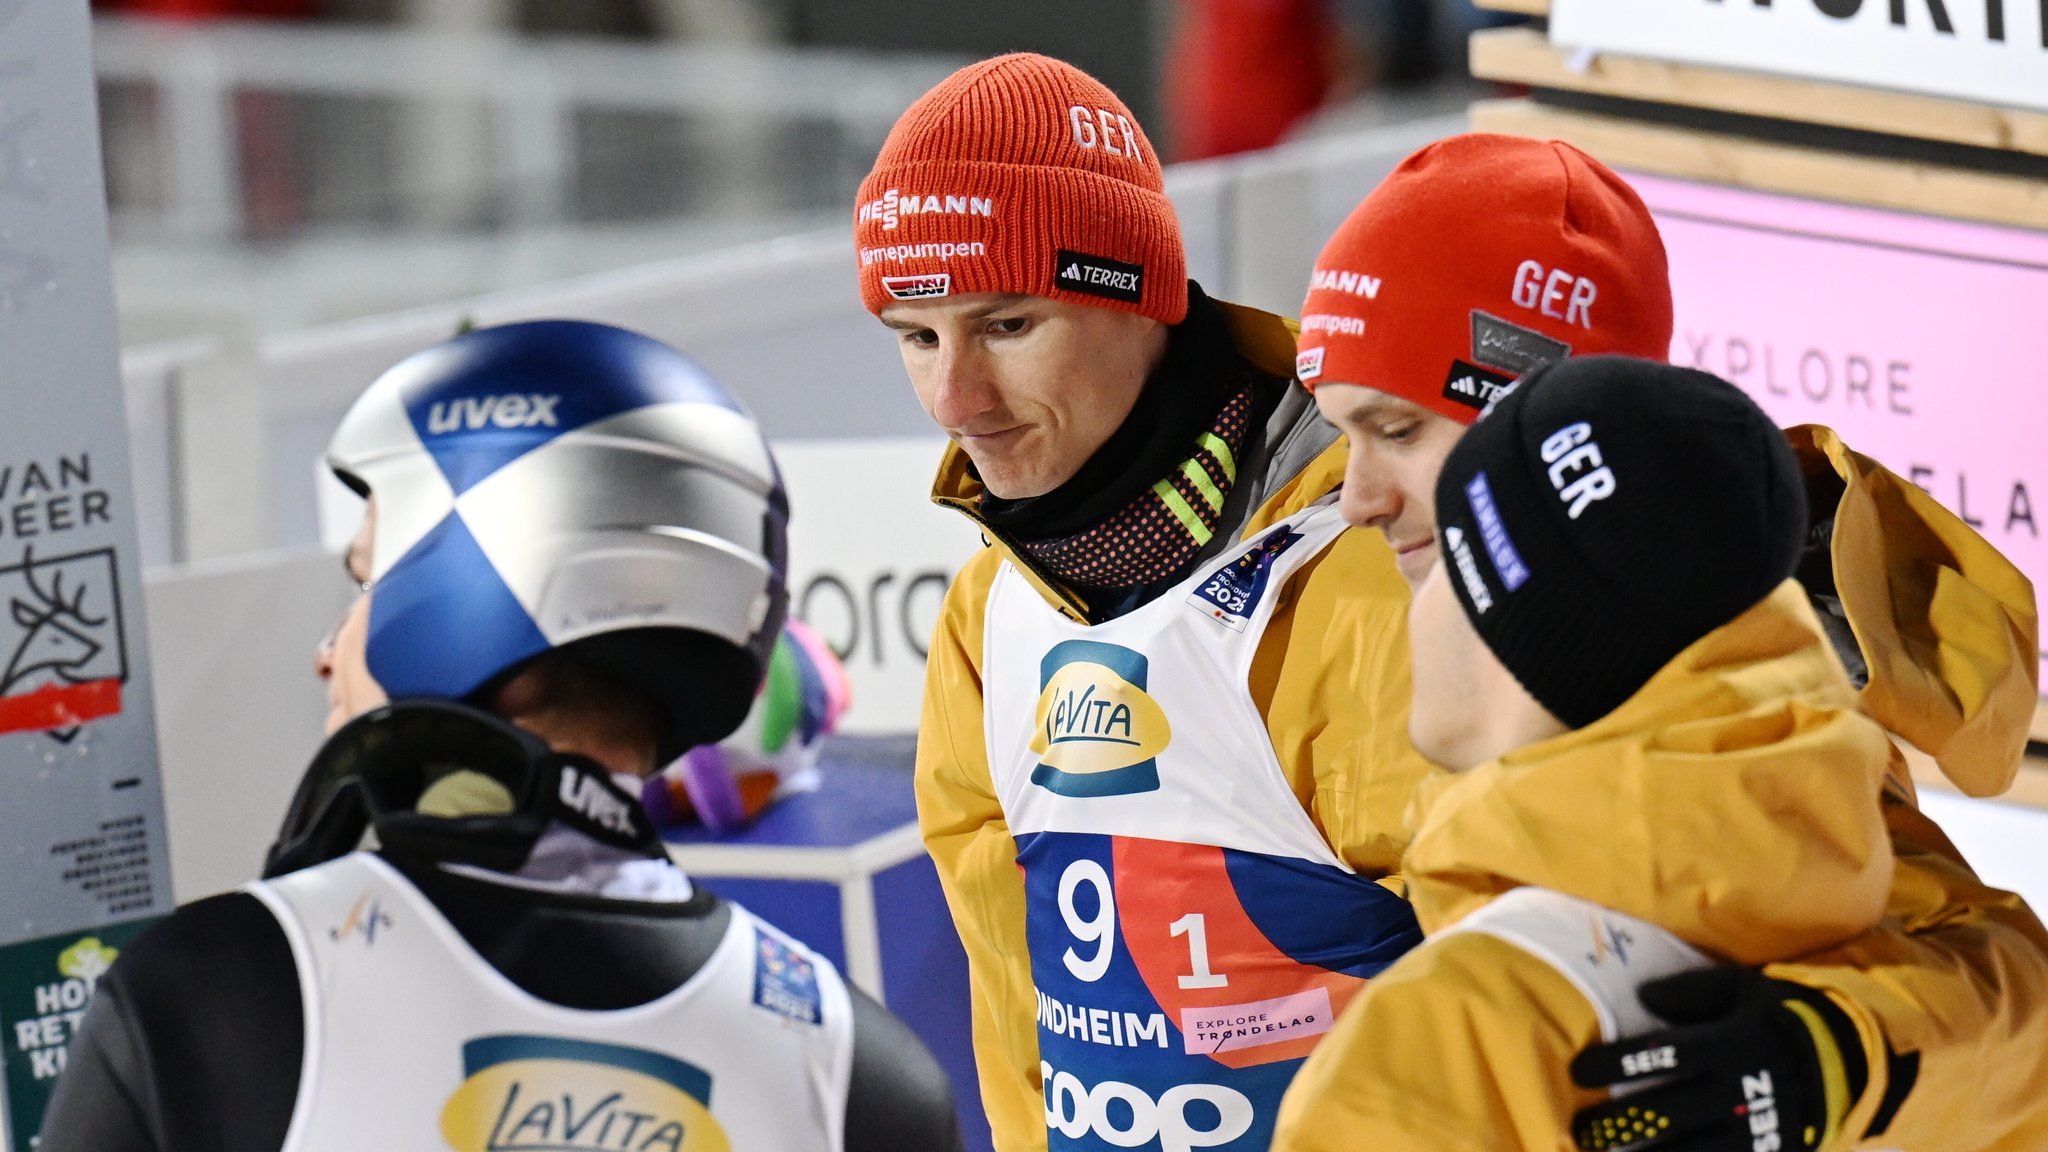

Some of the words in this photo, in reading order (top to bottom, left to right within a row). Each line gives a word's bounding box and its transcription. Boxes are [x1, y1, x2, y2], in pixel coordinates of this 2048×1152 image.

[1069, 105, 1143, 164] GER
[1083, 265, 1140, 292] TERREX
[1511, 258, 1598, 331] GER
[427, 393, 562, 435] uvex
[1540, 420, 1617, 521] GER
[0, 489, 110, 539] EER
[1057, 858, 1116, 983] 9
[1169, 912, 1229, 990] 1
[1196, 1013, 1268, 1029] EXPLORE
[1197, 1015, 1315, 1050] TRØNDELAG
